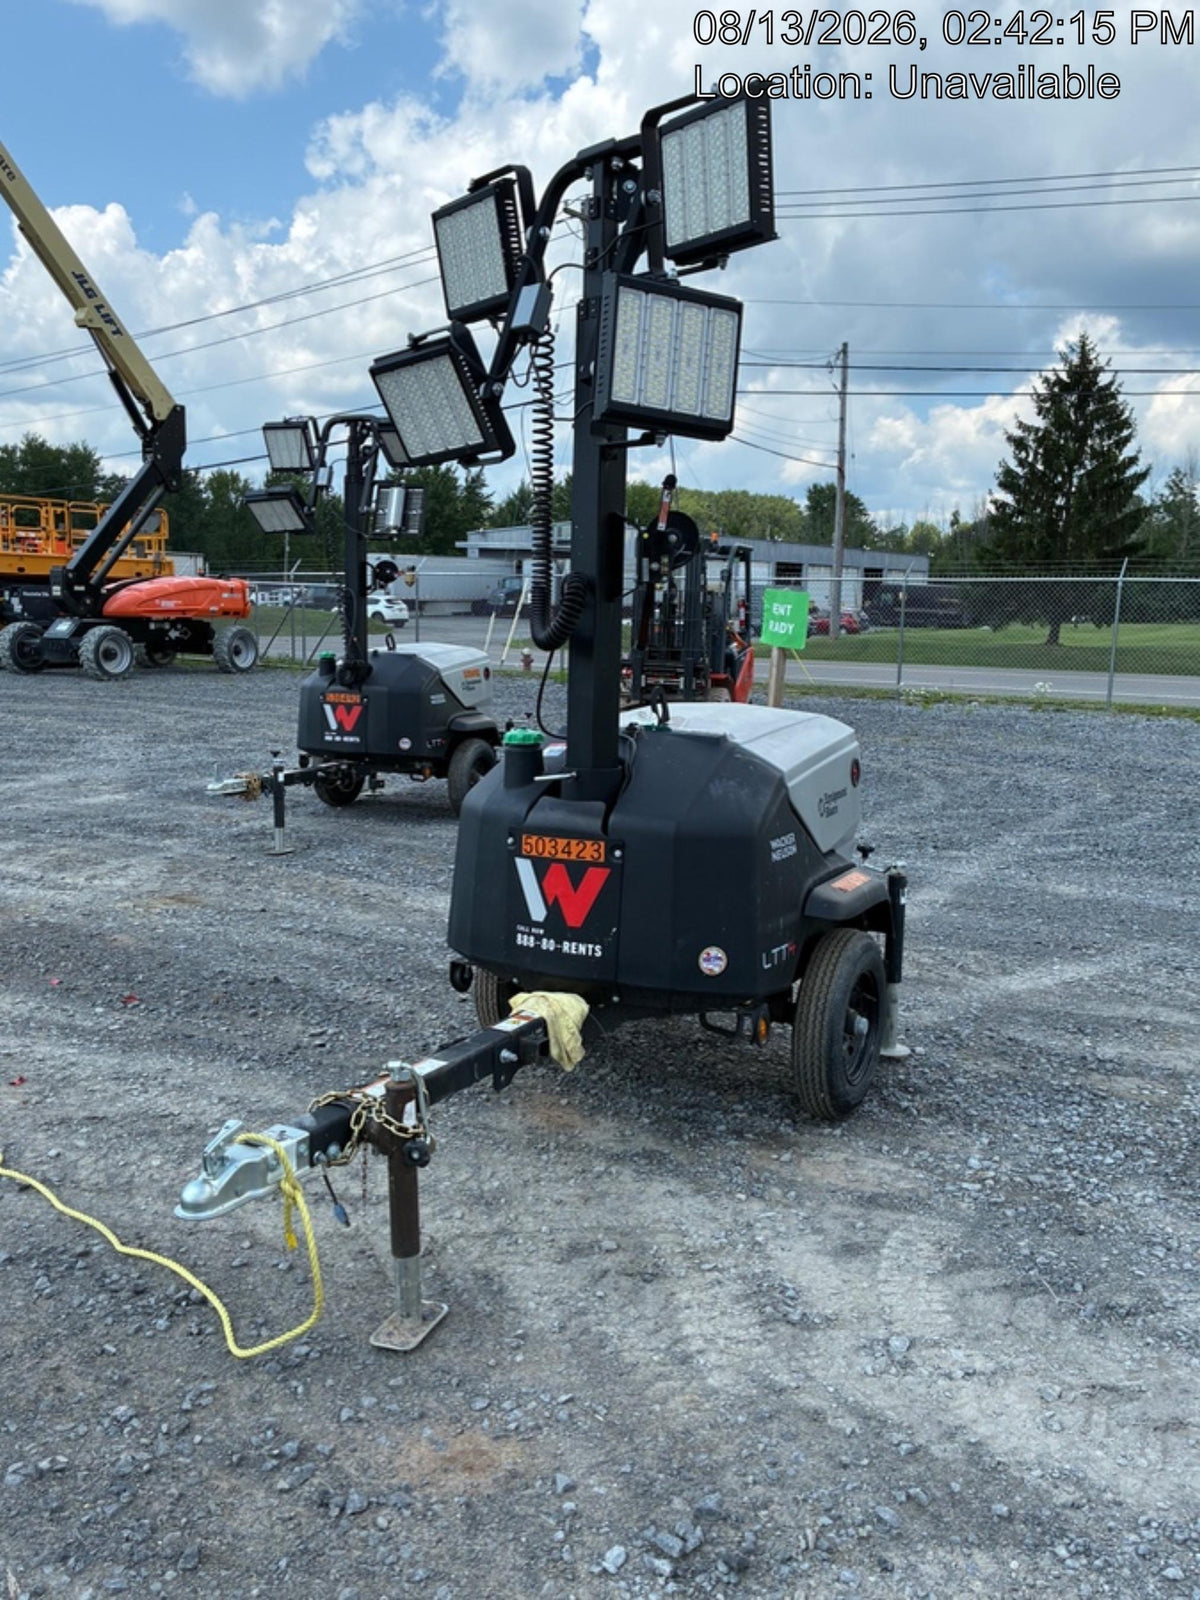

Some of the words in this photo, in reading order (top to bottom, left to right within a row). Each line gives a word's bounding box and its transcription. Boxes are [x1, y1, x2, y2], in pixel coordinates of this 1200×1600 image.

[72, 271, 97, 299] JLG
[94, 304, 123, 336] LIFT
[523, 837, 602, 860] 503423
